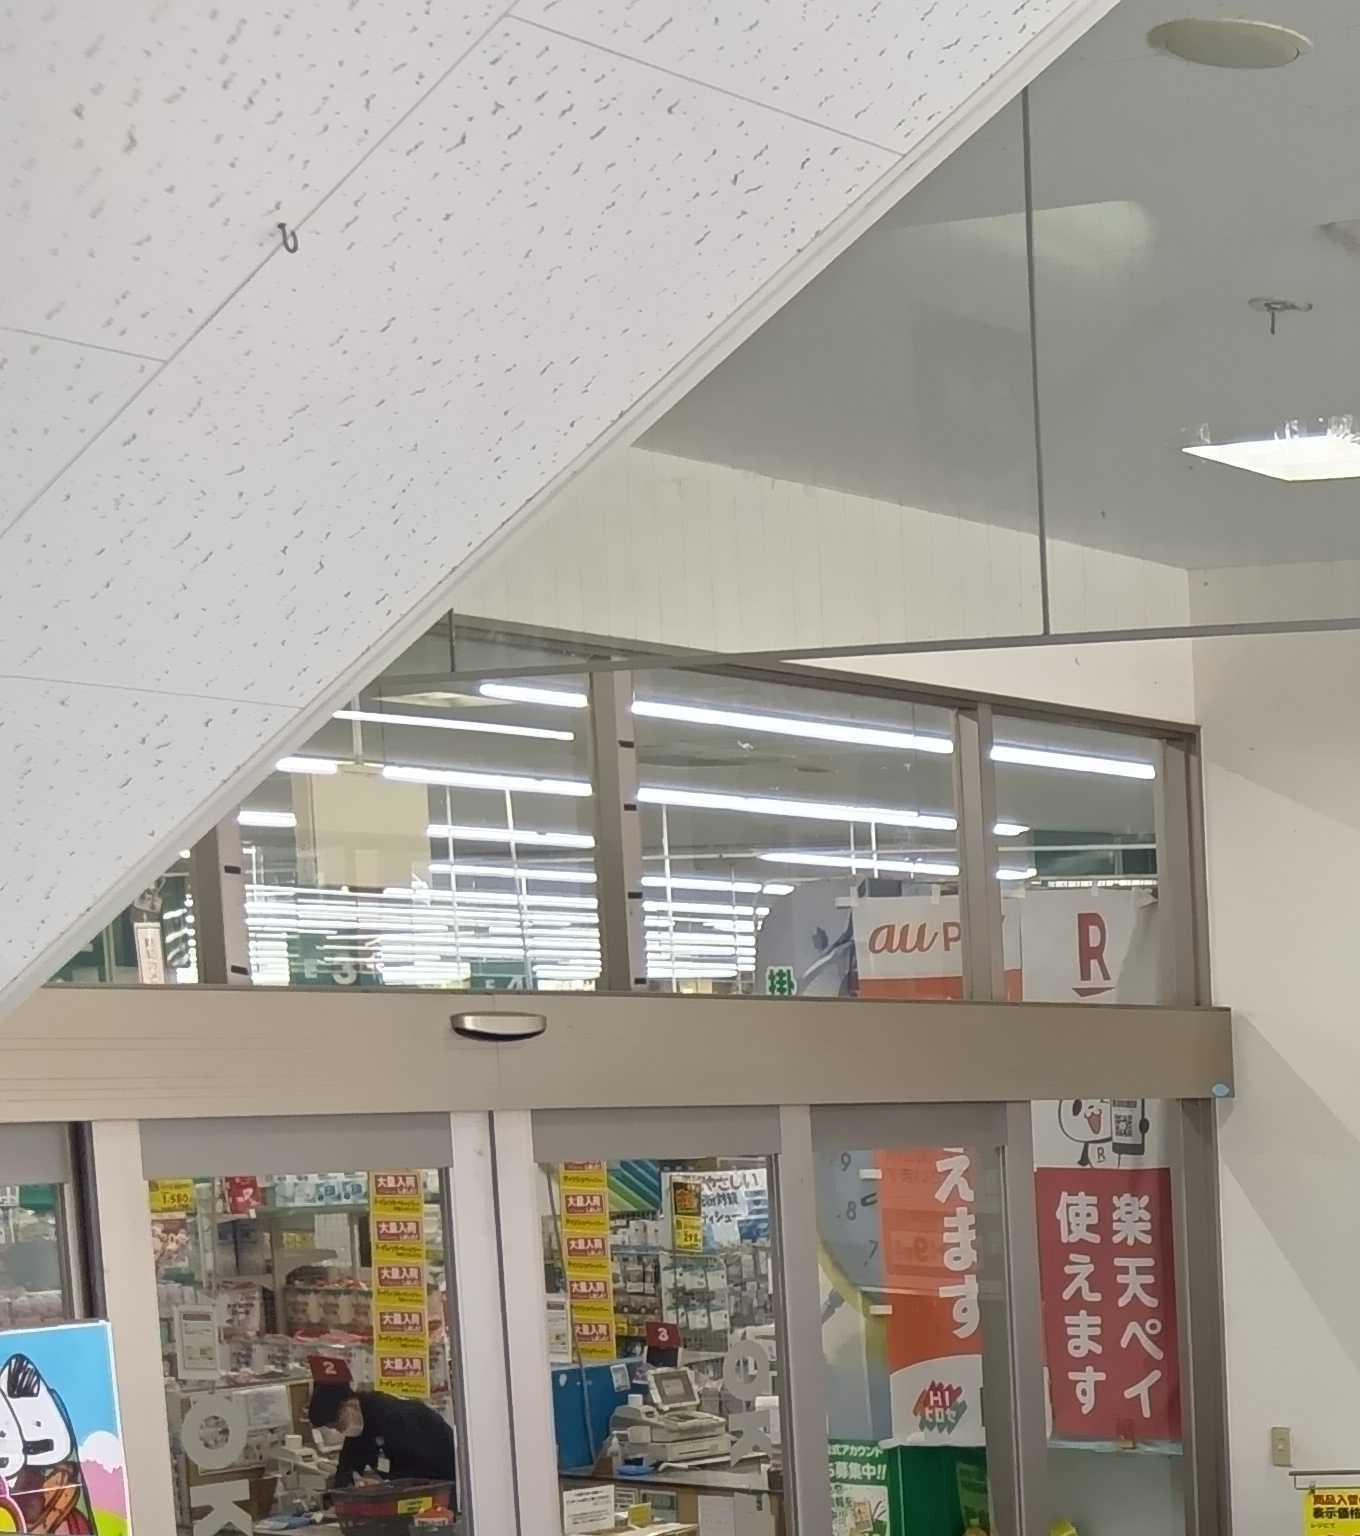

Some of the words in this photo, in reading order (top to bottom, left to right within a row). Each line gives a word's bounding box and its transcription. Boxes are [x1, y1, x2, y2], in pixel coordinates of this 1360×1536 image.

[868, 921, 940, 955] au
[1055, 1192, 1107, 1416] 使えます
[1111, 1194, 1164, 1419] 楽天ペイ
[322, 1361, 338, 1376] 2
[929, 1390, 950, 1406] HI
